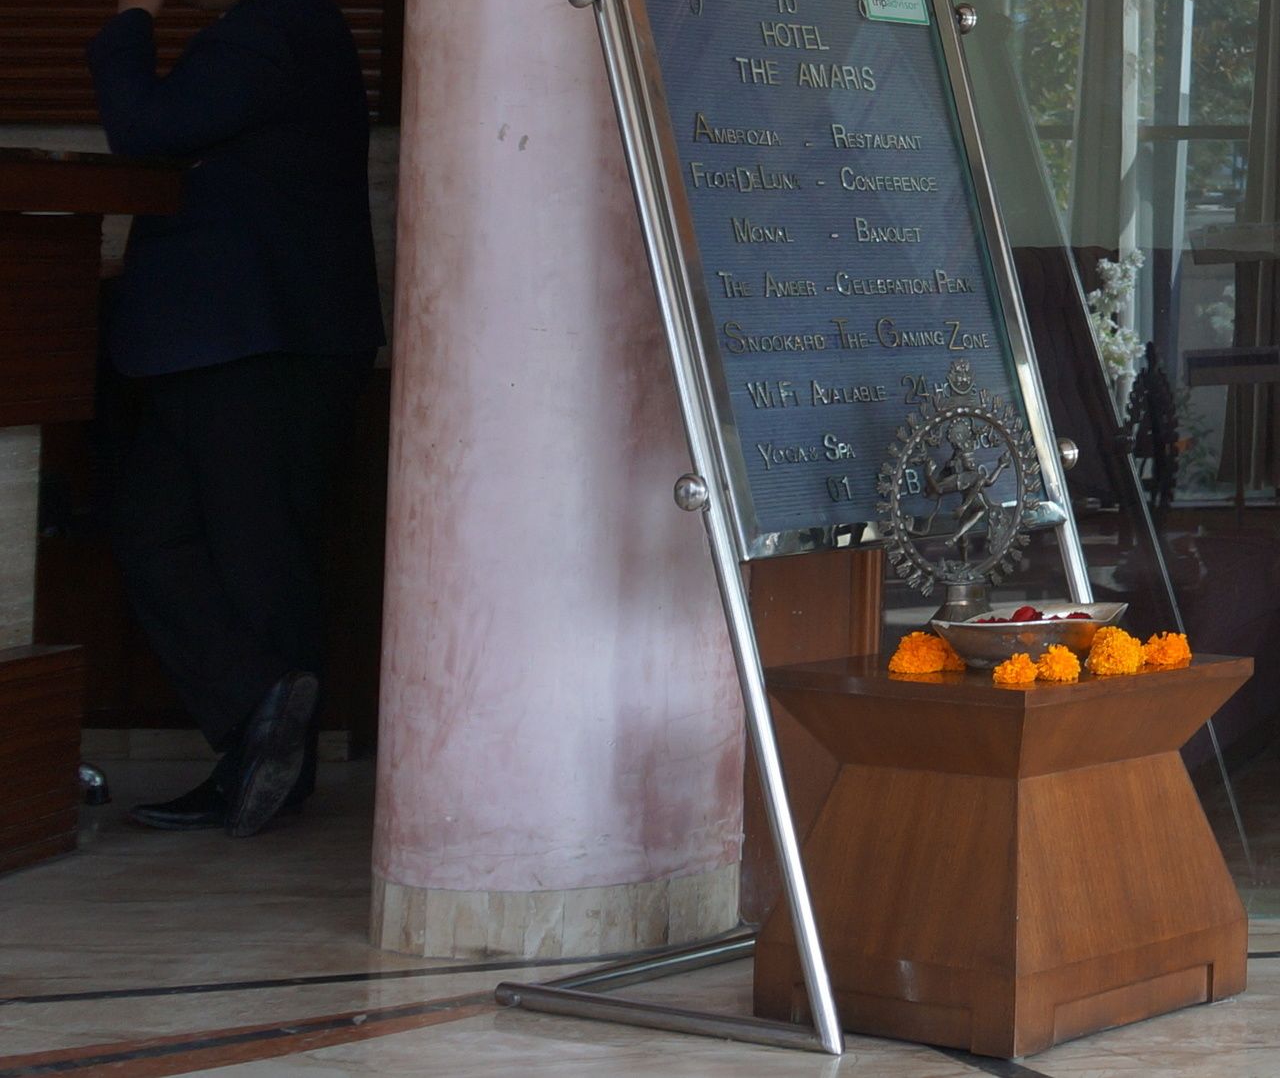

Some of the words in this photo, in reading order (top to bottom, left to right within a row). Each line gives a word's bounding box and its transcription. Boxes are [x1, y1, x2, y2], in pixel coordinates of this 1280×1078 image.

[761, 22, 829, 50] HOTEL
[735, 57, 780, 85] THE
[798, 64, 877, 91] AMARIS
[831, 123, 922, 150] RESTAURANT
[840, 166, 940, 192] CONFERENCE
[854, 217, 922, 243] BANQUET
[717, 270, 751, 298] THE
[764, 270, 817, 298] AMBER
[944, 320, 991, 351] ZONE
[901, 374, 930, 405] 24
[822, 432, 856, 463] SPA
